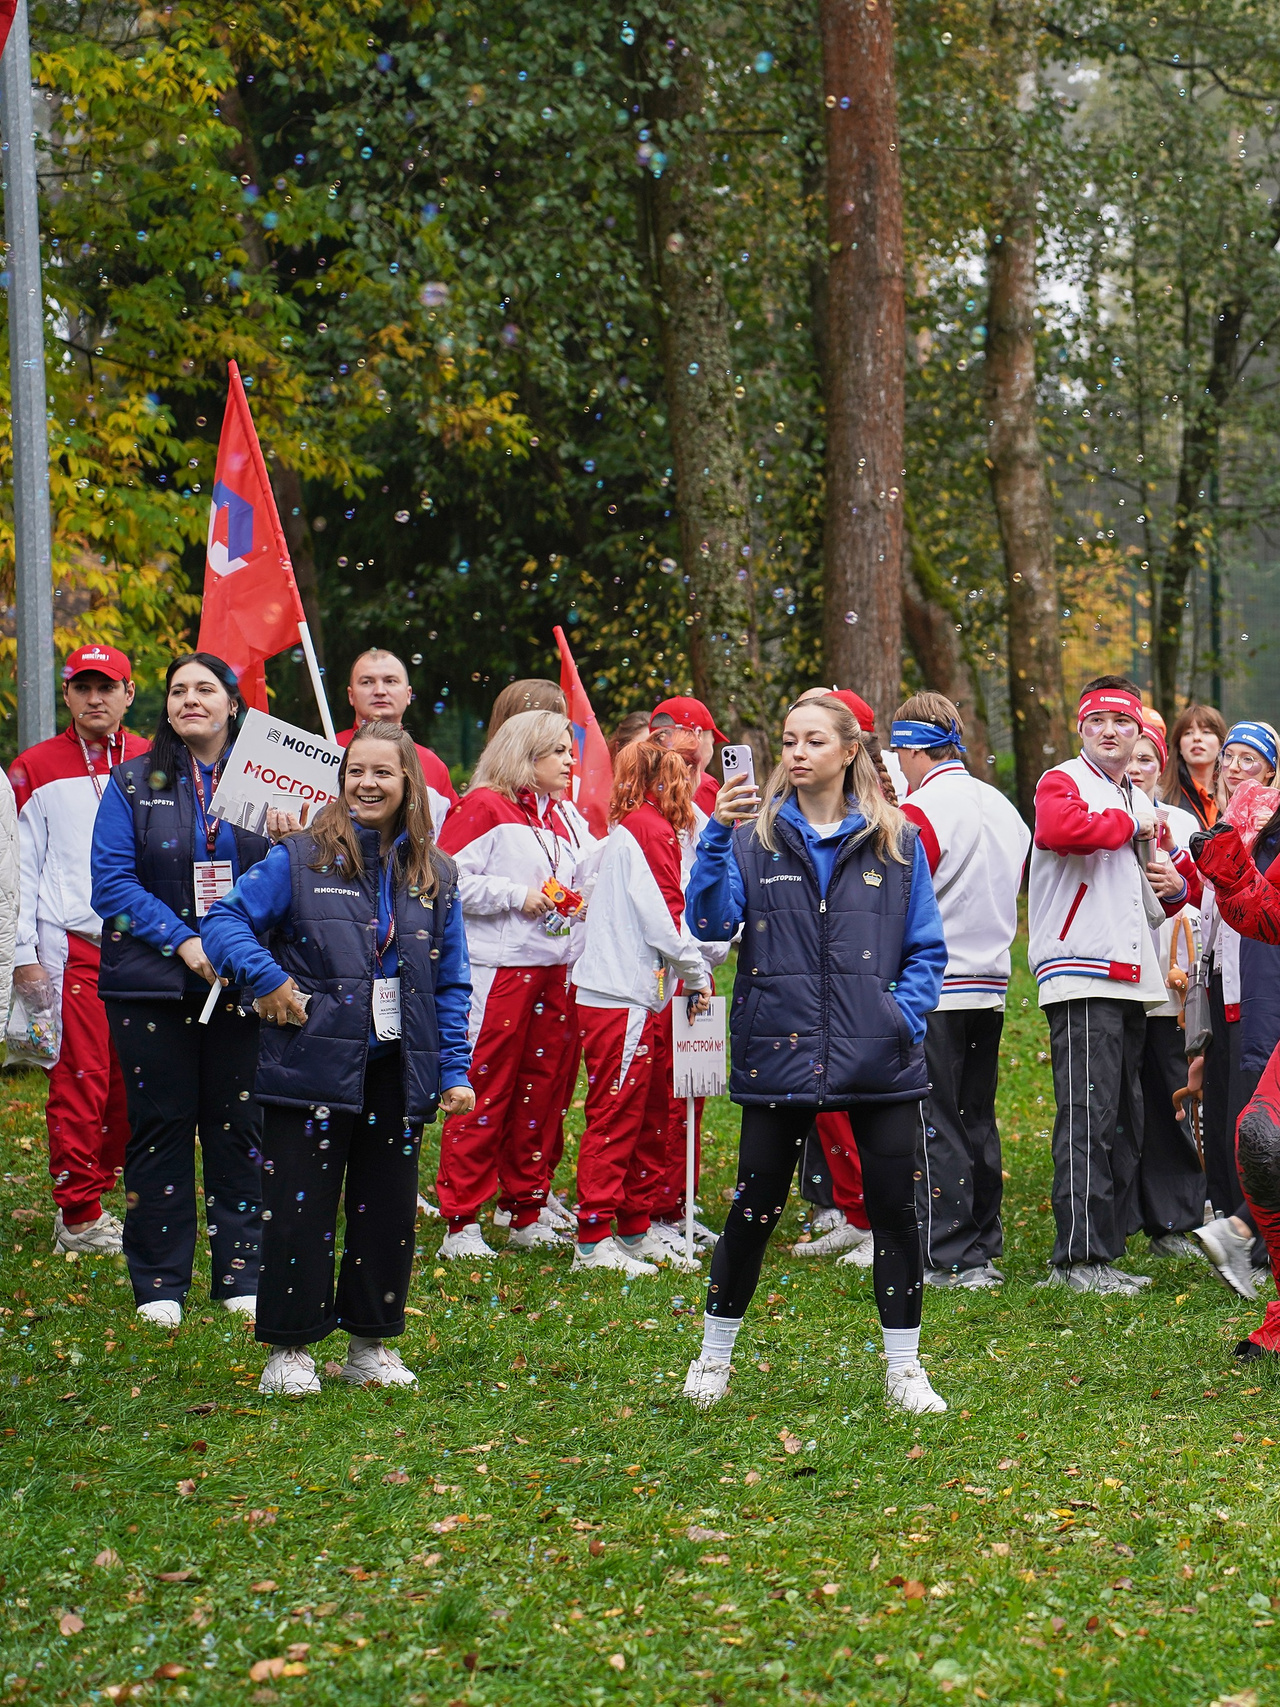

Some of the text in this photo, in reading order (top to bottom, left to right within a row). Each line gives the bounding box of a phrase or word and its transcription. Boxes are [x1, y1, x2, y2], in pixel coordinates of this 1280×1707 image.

[282, 734, 341, 768] МОСГОР
[320, 887, 360, 897] МОСГОРБТИ
[379, 990, 396, 1000] XVIII
[676, 1036, 724, 1053] МИП-СТРОЙ №1
